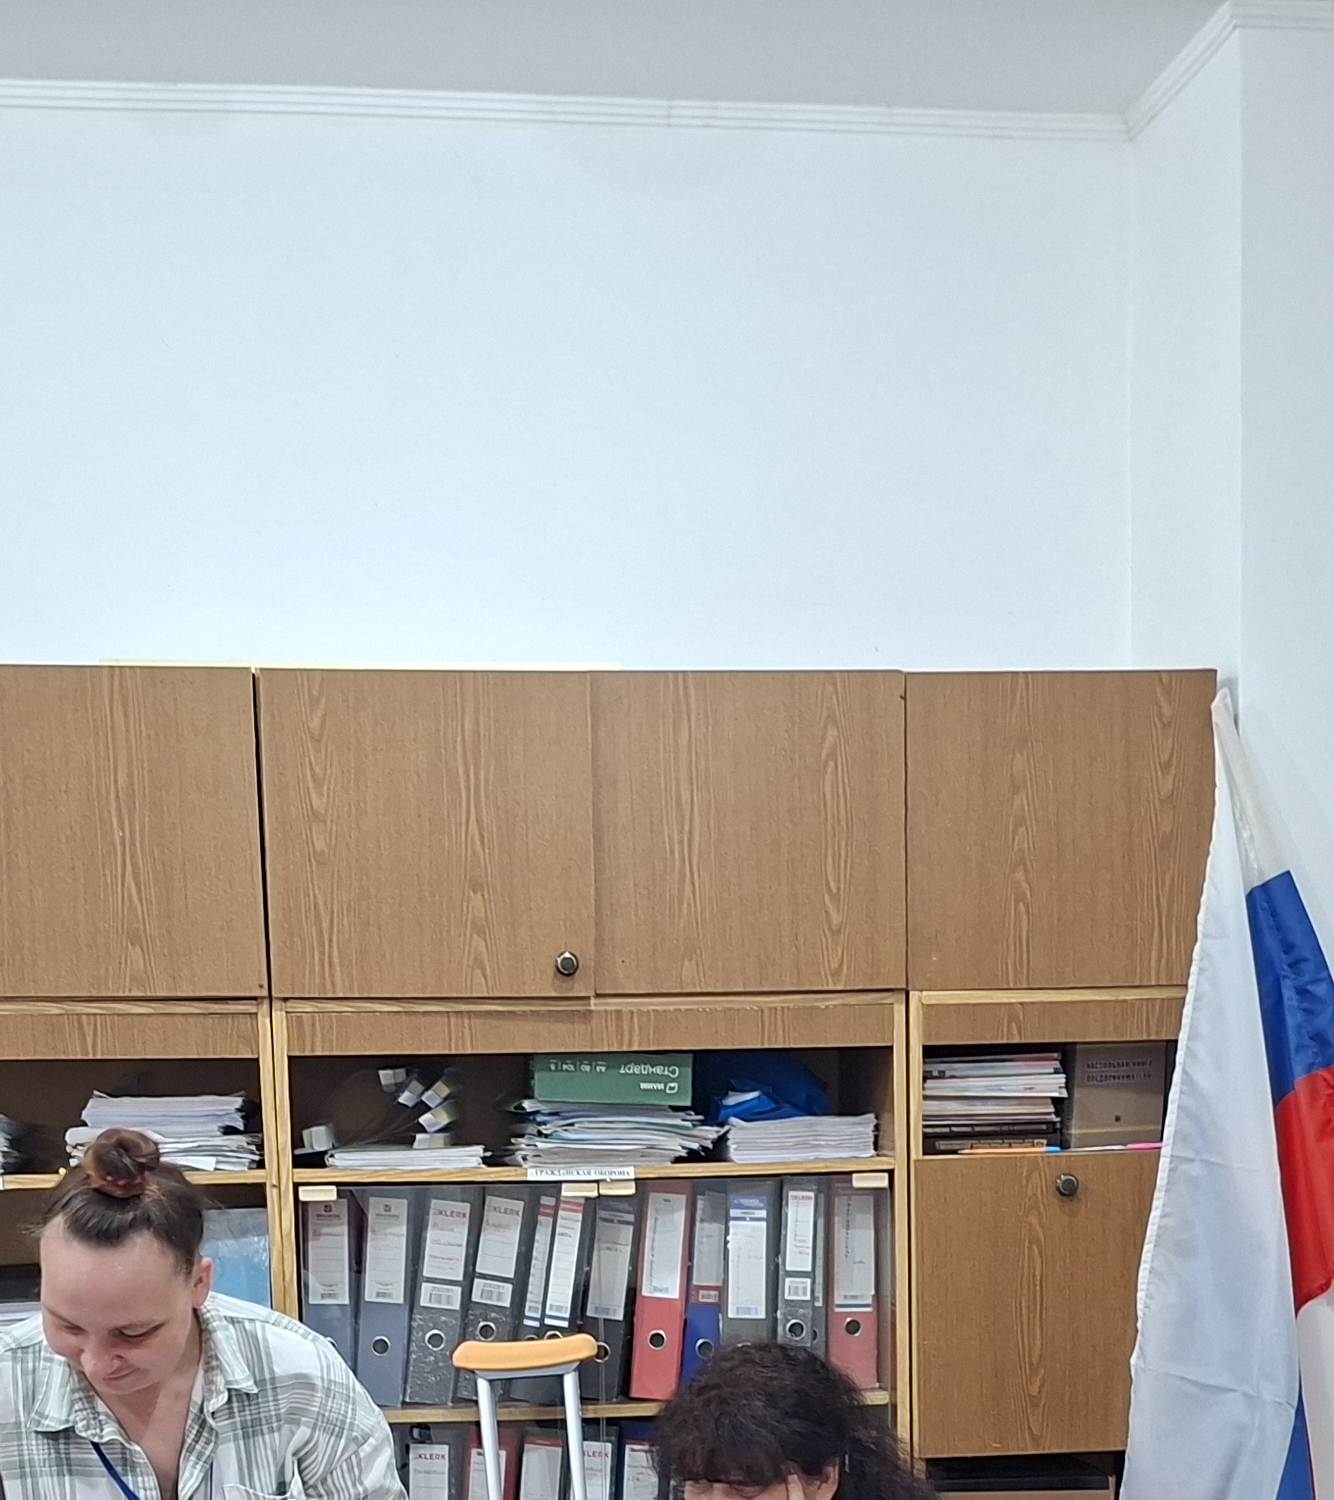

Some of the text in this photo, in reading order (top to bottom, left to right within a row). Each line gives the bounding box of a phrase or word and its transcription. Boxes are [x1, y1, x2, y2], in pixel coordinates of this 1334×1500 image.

[619, 1062, 680, 1078] Стандарт
[437, 1208, 468, 1219] KLERK
[493, 1205, 521, 1217] KLERK
[417, 1453, 446, 1461] KLERK
